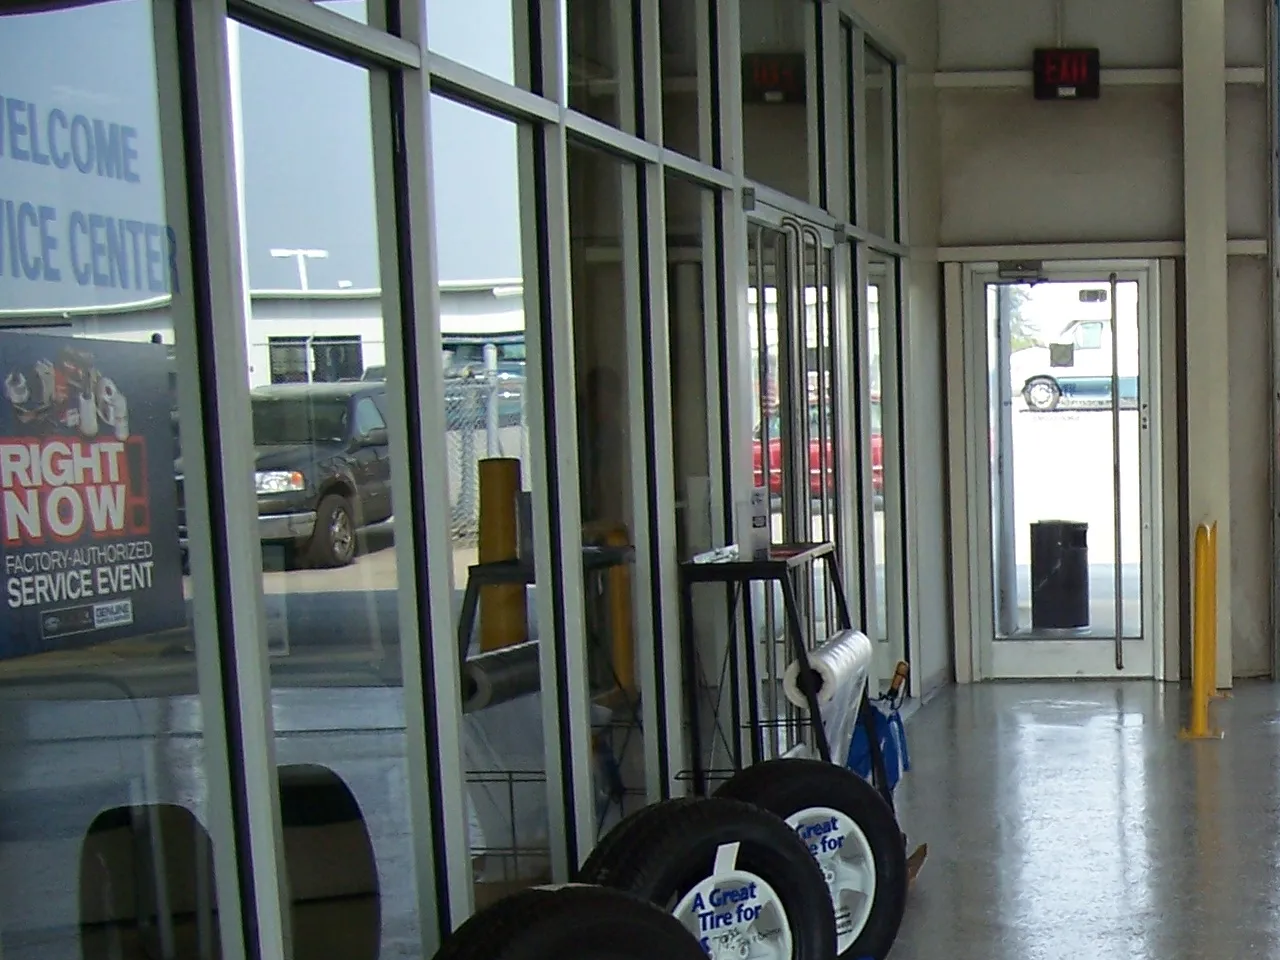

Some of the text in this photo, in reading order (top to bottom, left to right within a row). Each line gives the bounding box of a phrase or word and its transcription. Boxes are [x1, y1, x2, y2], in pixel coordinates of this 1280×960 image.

[0, 95, 140, 183] ELCOME
[0, 198, 181, 294] ICE CENTER
[0, 442, 124, 488] RIGHT
[4, 484, 126, 540] NOW
[6, 541, 153, 575] FACTORY-AUTHORIZED
[7, 561, 154, 608] SERVICE EVENT
[822, 835, 844, 853] for
[691, 881, 757, 913] A Great
[698, 903, 761, 932] Tire for
